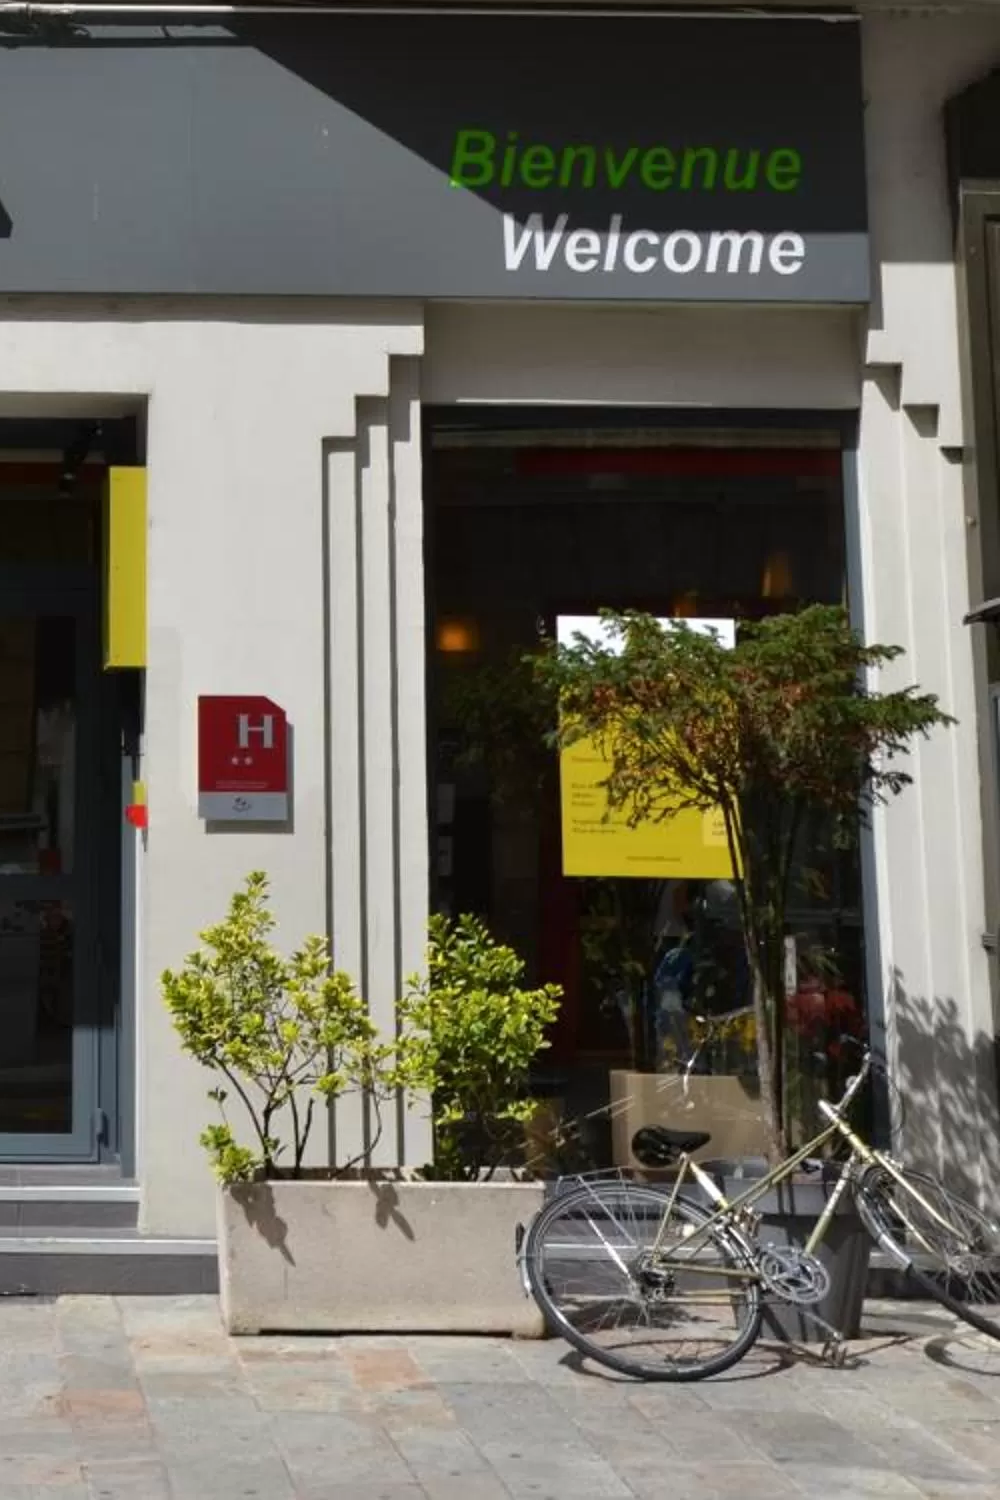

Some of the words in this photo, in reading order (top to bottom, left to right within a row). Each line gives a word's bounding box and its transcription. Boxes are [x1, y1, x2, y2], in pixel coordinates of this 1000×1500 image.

[449, 129, 802, 190] Bienvenue
[502, 212, 806, 276] Welcome
[238, 713, 274, 749] H
